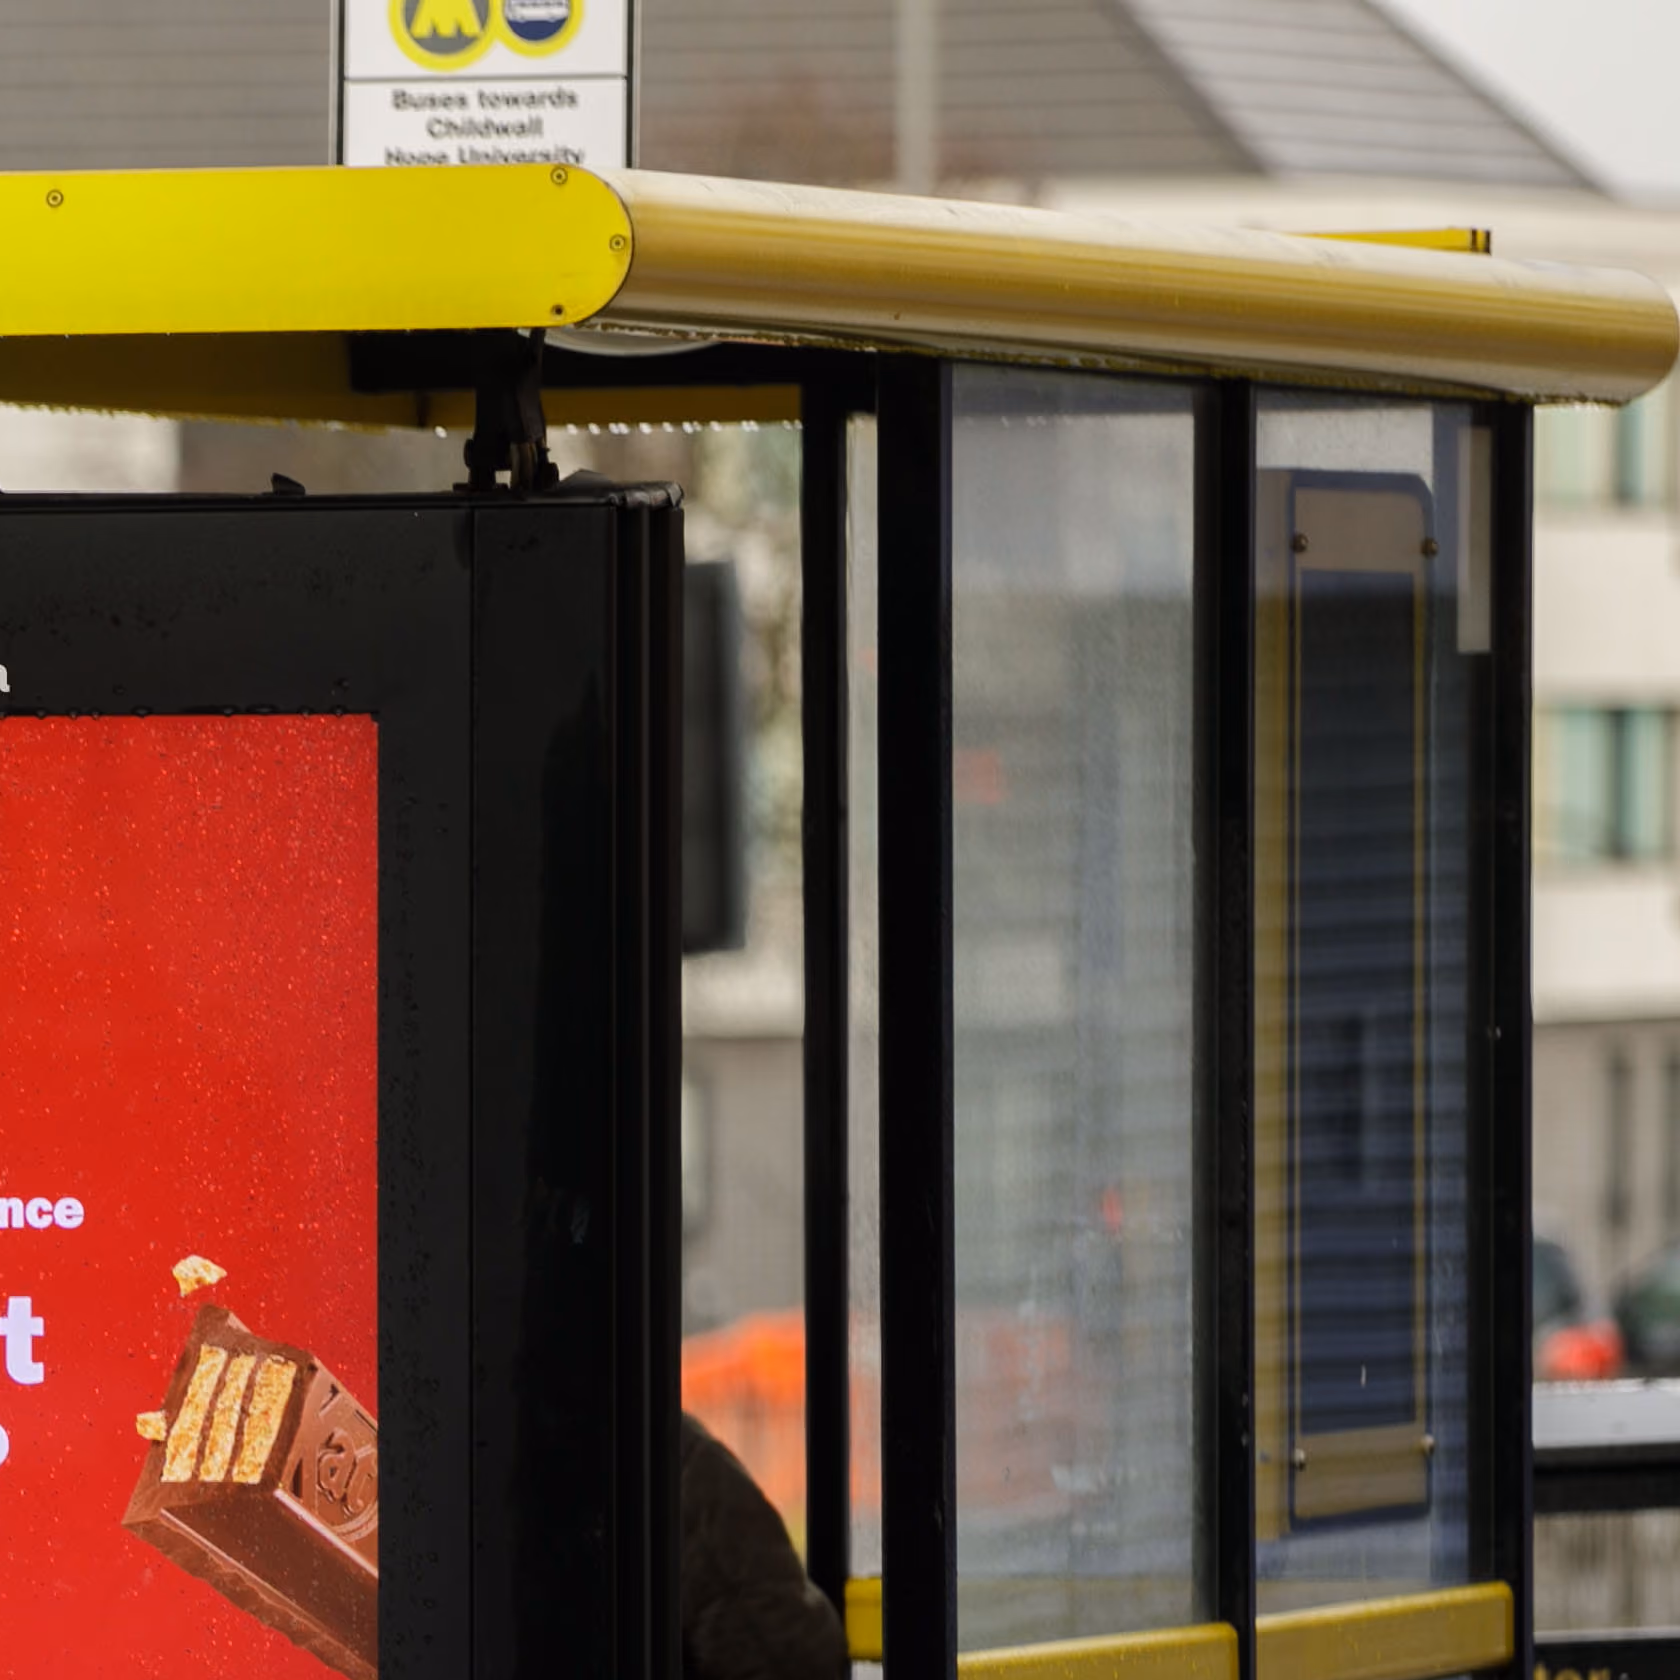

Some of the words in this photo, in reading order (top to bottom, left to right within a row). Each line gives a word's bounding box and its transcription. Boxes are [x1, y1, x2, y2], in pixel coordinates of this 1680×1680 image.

[392, 88, 468, 109] Buses
[477, 86, 578, 108] towards
[425, 115, 544, 139] Childwall
